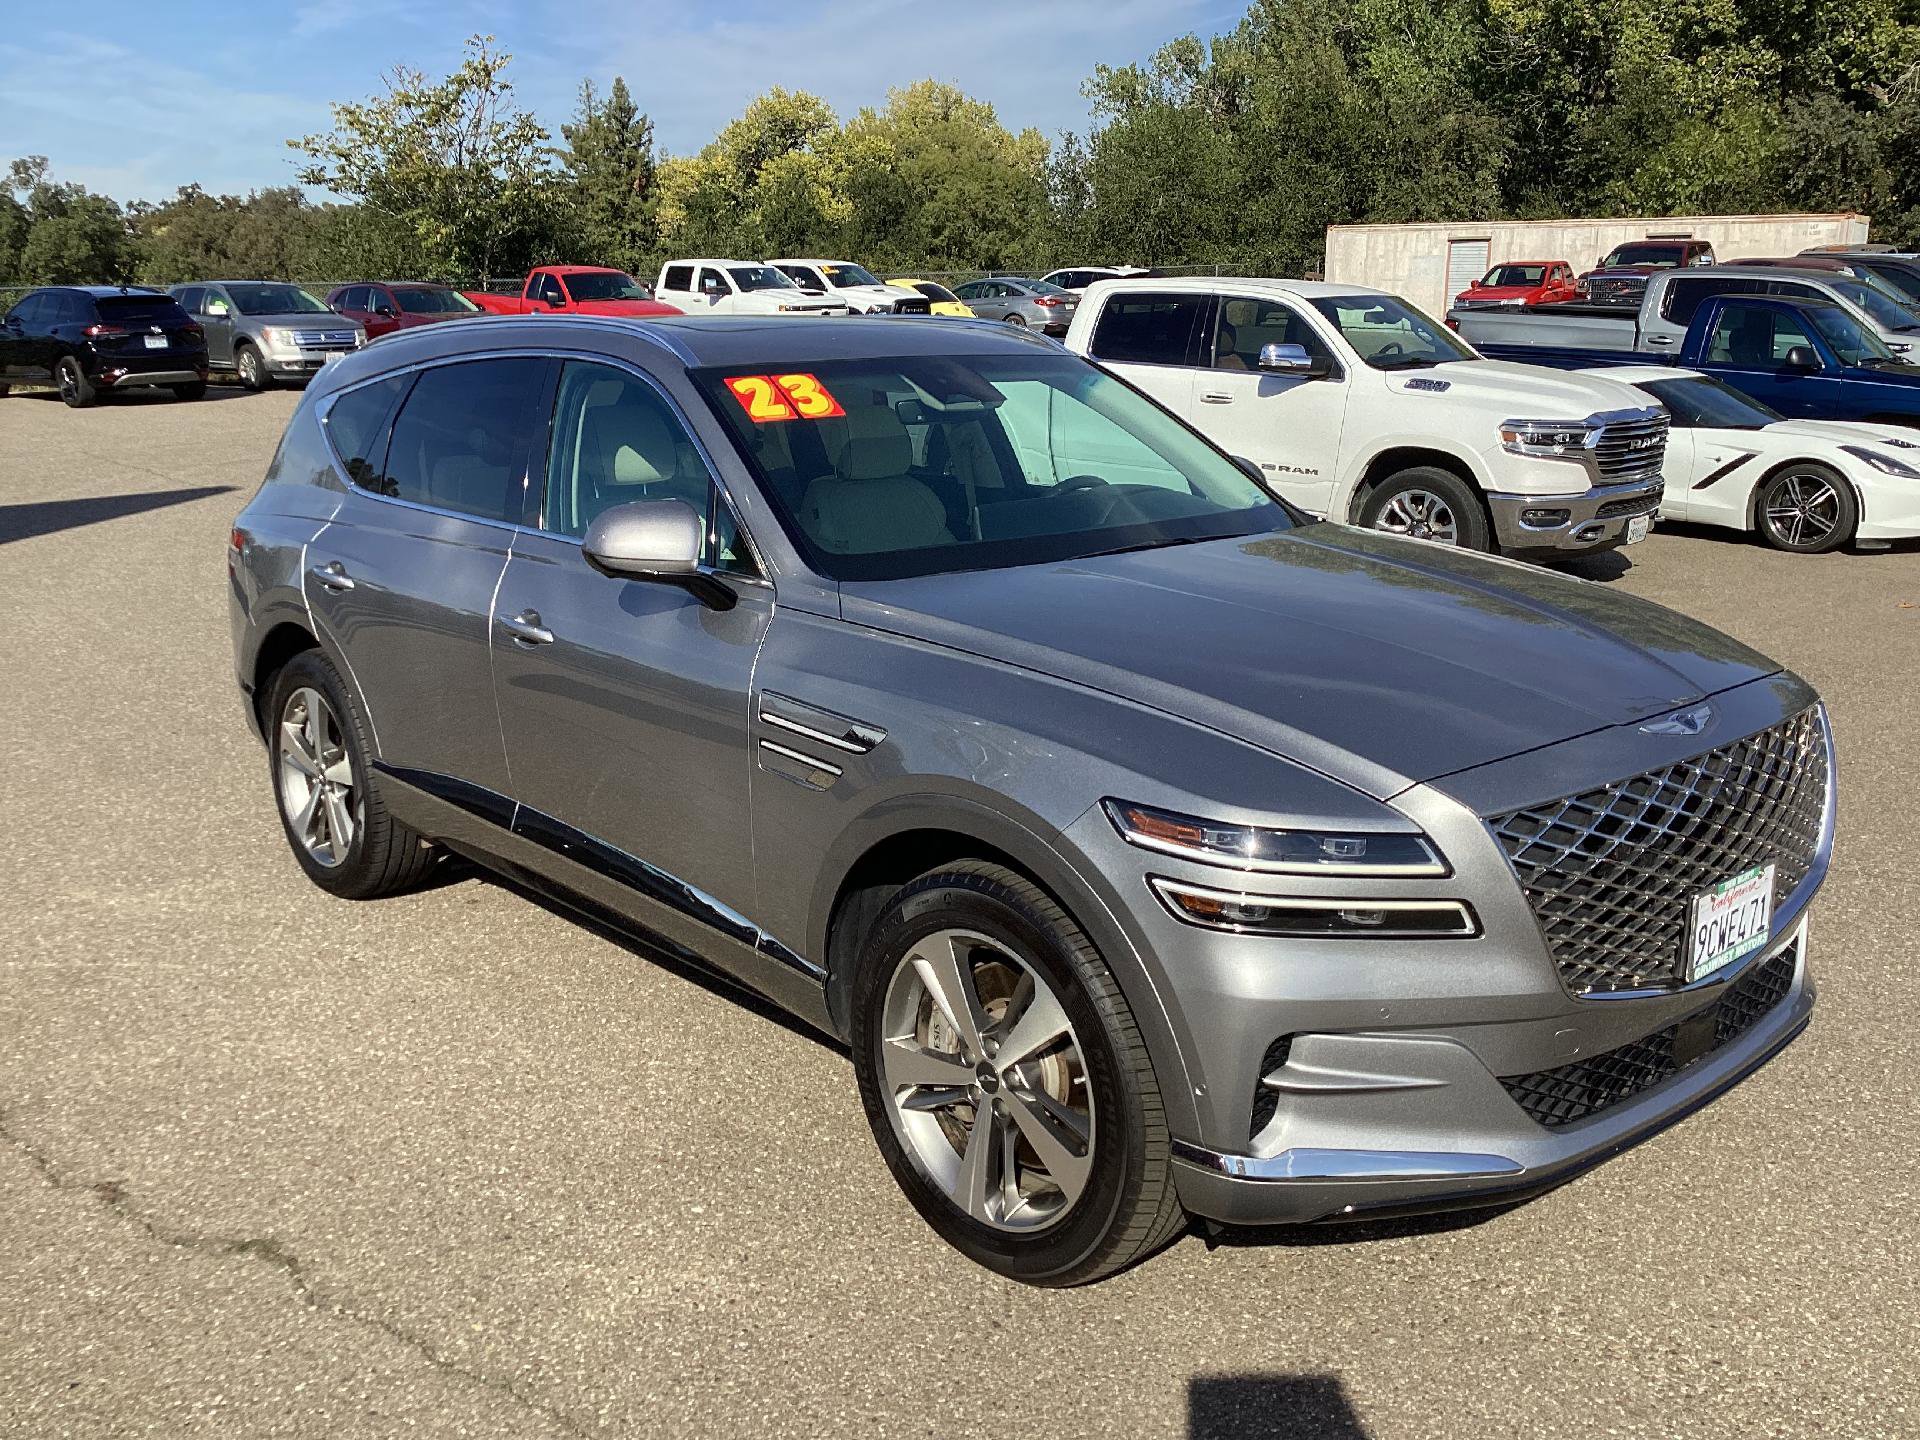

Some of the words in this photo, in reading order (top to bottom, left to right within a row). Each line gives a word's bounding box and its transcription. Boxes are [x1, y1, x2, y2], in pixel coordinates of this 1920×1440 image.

[733, 375, 834, 417] 23
[1629, 437, 1660, 450] RAM
[1278, 465, 1319, 476] RAM
[1695, 894, 1766, 966] 9CWE471
